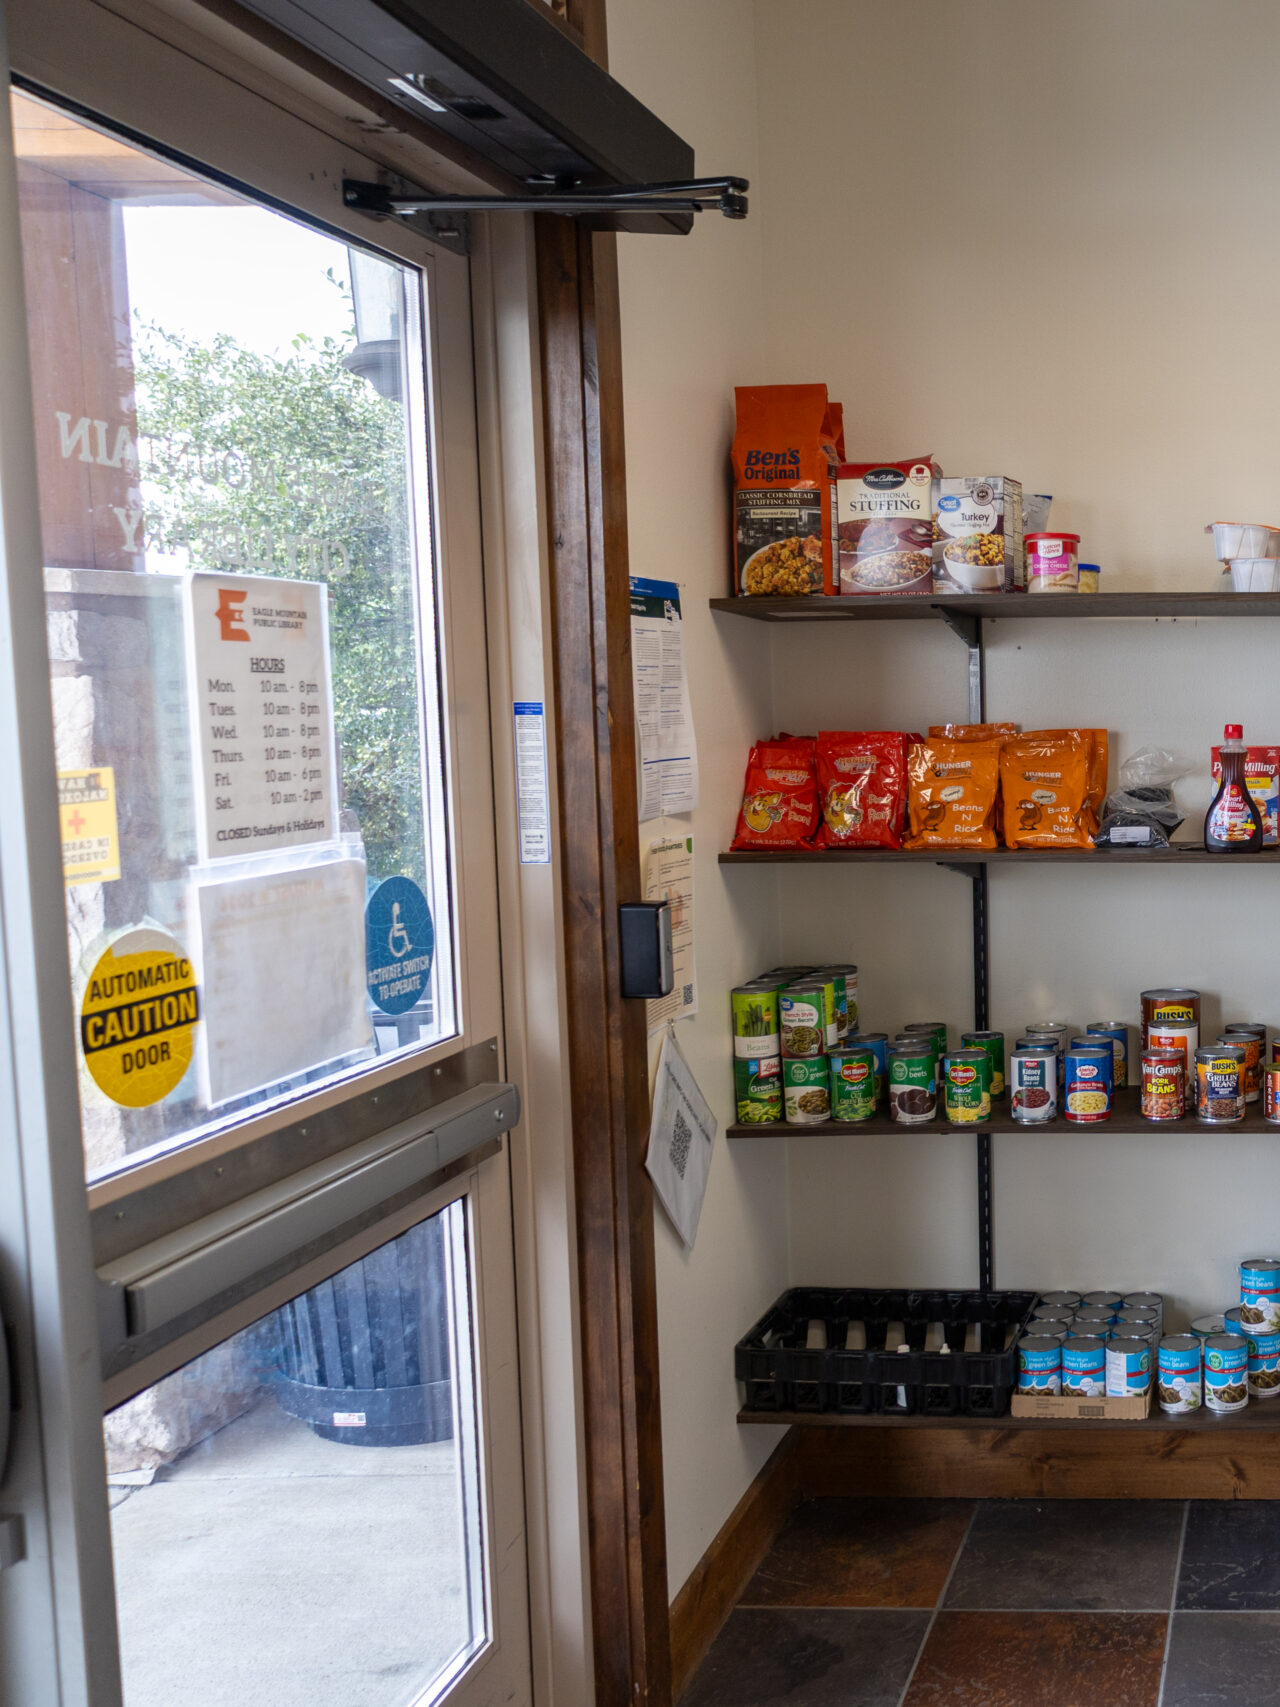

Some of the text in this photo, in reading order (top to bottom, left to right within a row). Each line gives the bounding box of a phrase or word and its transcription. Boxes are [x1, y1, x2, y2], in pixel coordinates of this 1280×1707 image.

[745, 448, 800, 466] Ben's
[744, 467, 800, 483] Original
[850, 500, 920, 512] STUFFING
[961, 513, 989, 522] Turkey
[252, 608, 307, 619] EAGLE MOUNTAIN
[253, 618, 303, 629] PUBLIC LIBRARY
[250, 658, 285, 673] HOURS
[260, 681, 319, 695] 10 8 pm
[263, 703, 320, 717] 10 8 pm
[263, 724, 306, 737] 10 8
[265, 748, 276, 760] 10
[935, 761, 972, 770] HUNGER
[1244, 762, 1277, 774] Milling
[265, 771, 276, 782] 10
[1025, 771, 1061, 779] HUNGER
[271, 793, 281, 804] 10
[952, 804, 983, 812] Beans
[217, 819, 325, 841] CLOSED Sundays Holidays
[954, 825, 977, 833] Rice
[1053, 825, 1075, 833] Rice
[367, 954, 430, 988] ACTIVATE SWITCH
[89, 958, 190, 1002] AUTOMATIC
[392, 976, 421, 998] OPERATE
[85, 990, 197, 1049] CAUTION
[122, 1041, 171, 1074] DOOR
[1022, 1068, 1041, 1076] Kidney
[1212, 1062, 1236, 1070] BUSH'S
[751, 1084, 774, 1093] Green
[1147, 1084, 1175, 1093] BEANS
